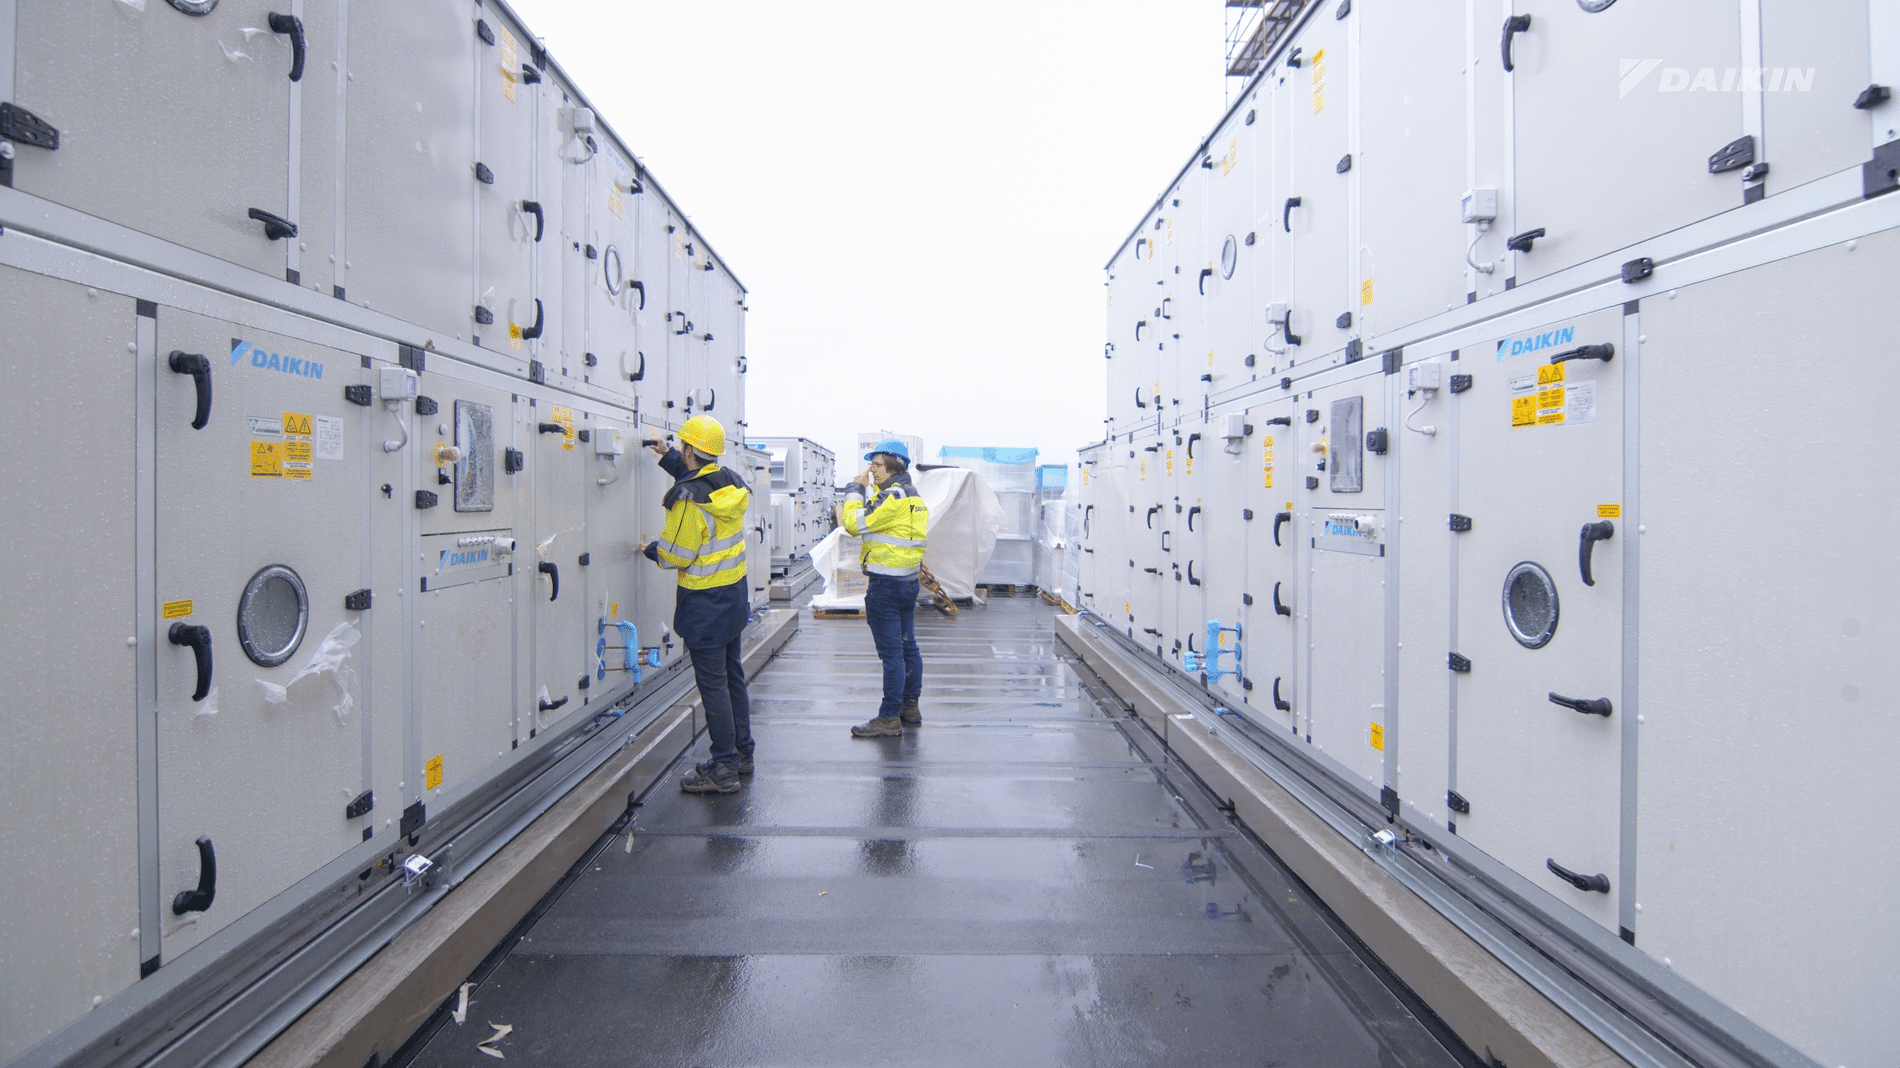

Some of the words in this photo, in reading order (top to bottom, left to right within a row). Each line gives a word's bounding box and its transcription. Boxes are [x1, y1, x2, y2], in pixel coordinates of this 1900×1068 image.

[1510, 326, 1575, 356] DAIKIN
[251, 348, 324, 379] DAIKIN
[449, 548, 488, 566] DAIKIN
